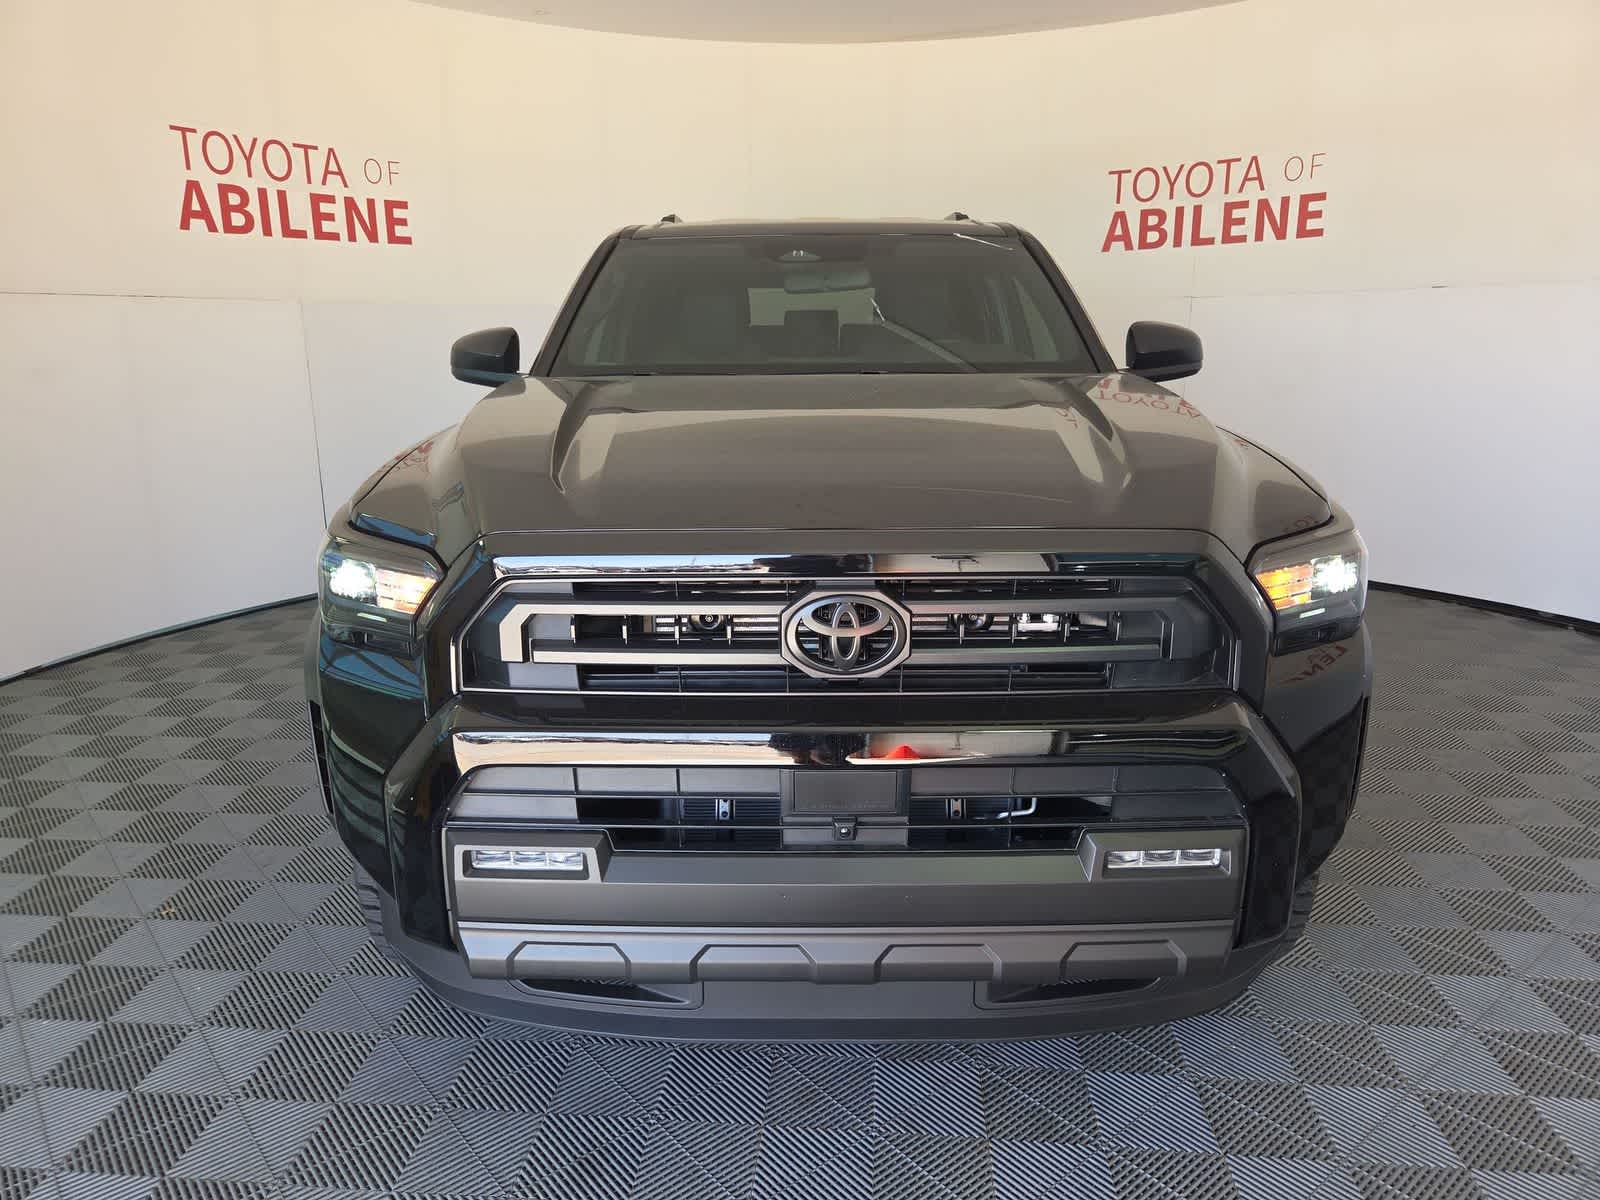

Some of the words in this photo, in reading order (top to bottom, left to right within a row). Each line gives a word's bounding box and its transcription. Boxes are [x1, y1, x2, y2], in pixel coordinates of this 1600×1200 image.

[169, 124, 349, 189] TOYOTA
[363, 157, 401, 186] OF
[1108, 155, 1266, 205] TOYOTA
[1283, 152, 1327, 181] OF
[179, 179, 413, 246] ABILENE
[1101, 191, 1328, 253] ABILENE
